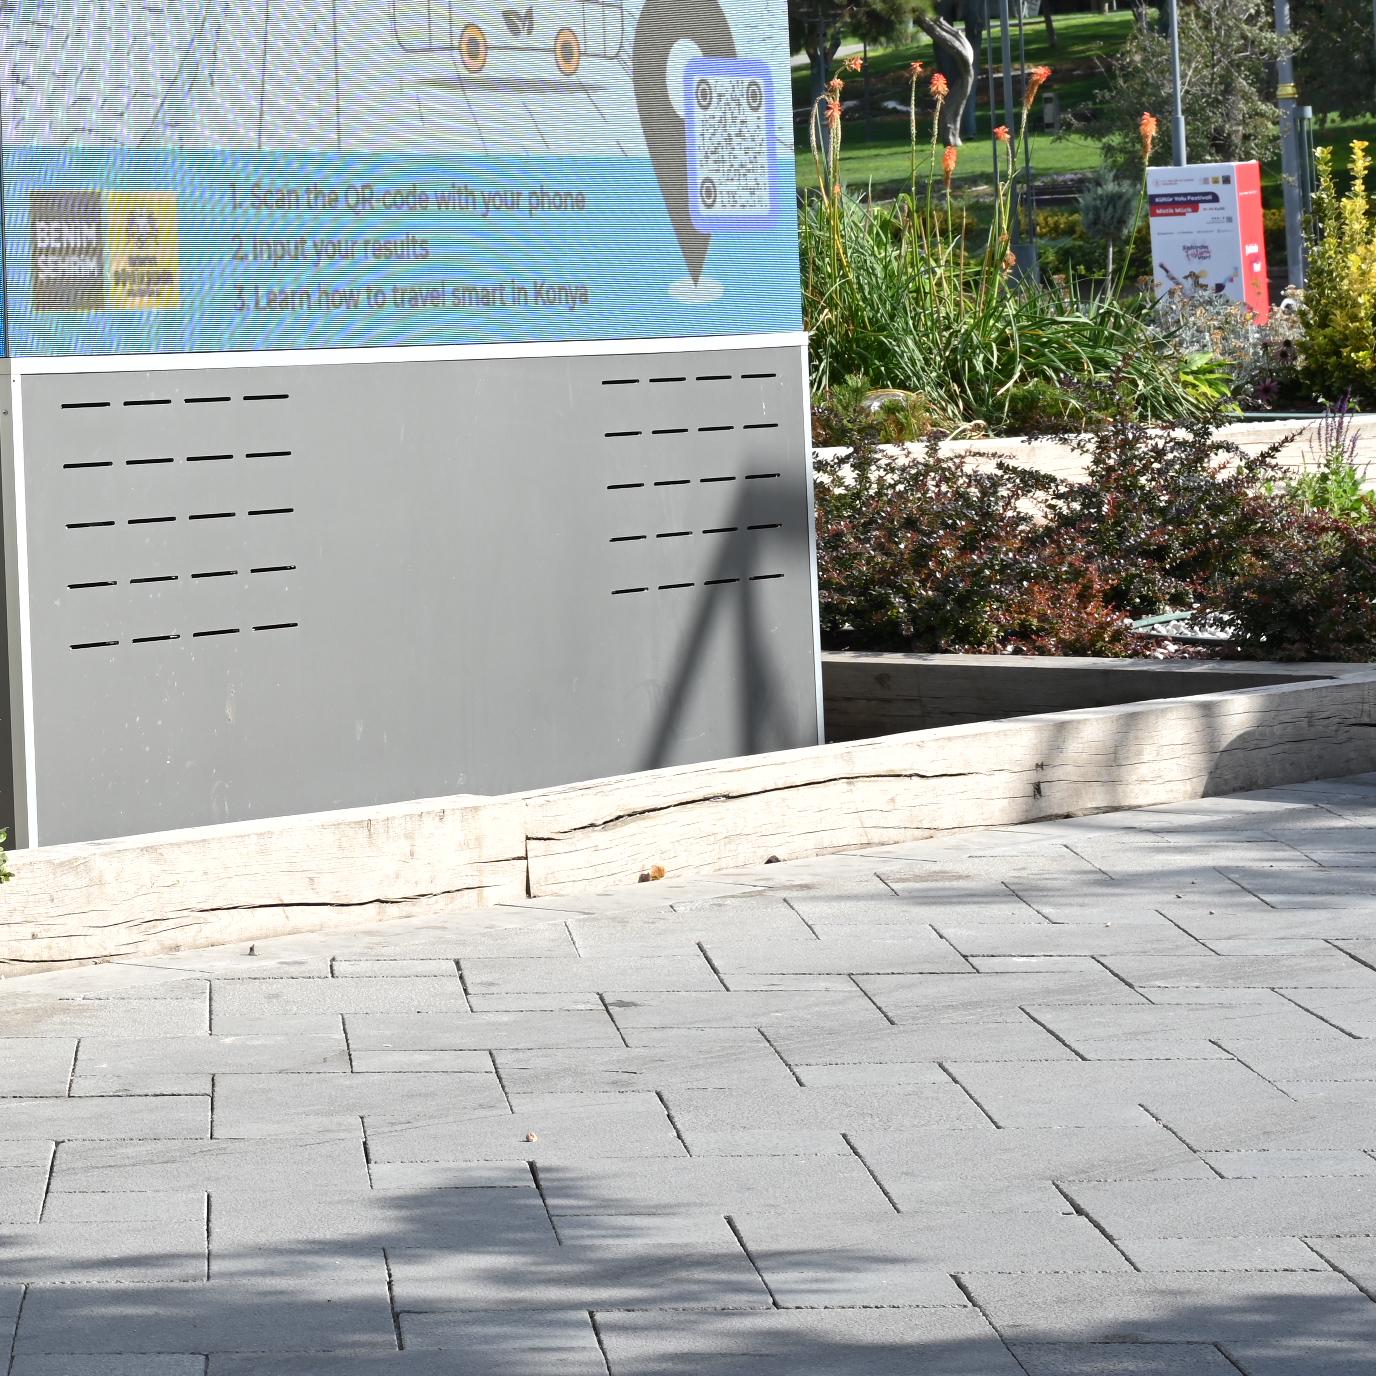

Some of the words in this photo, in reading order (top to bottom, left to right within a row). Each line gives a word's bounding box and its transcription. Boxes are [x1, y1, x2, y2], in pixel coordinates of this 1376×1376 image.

[250, 182, 300, 210] Scan
[306, 182, 339, 210] the
[436, 182, 477, 211] with
[480, 189, 523, 217] your
[528, 184, 586, 217] phone
[252, 235, 308, 268] Input
[313, 238, 358, 267] your
[363, 232, 430, 260] results
[254, 284, 312, 312] Learn
[318, 283, 361, 310] how
[366, 285, 386, 309] to
[392, 280, 446, 309] travel
[451, 283, 506, 308] smart
[510, 279, 529, 306] in
[533, 280, 590, 312] Konya
